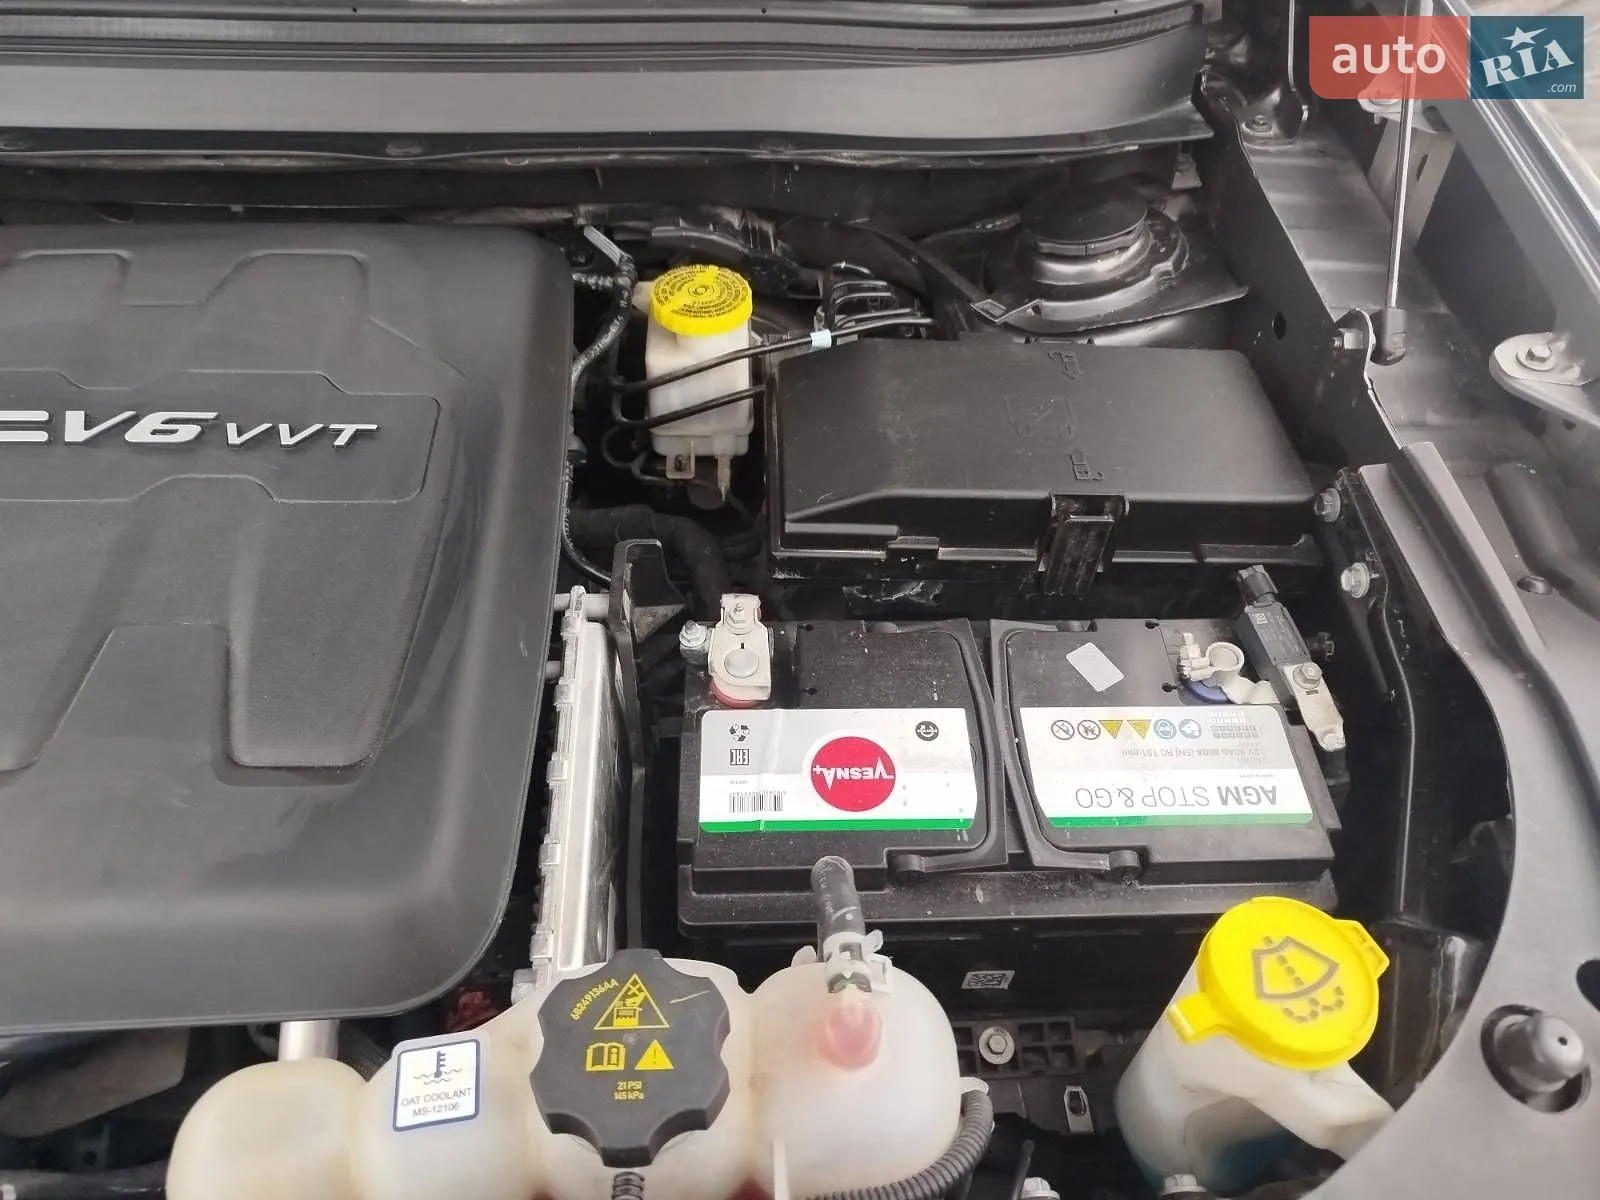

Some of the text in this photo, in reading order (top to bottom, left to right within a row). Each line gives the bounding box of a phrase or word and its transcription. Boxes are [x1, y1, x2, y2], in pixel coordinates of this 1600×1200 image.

[64, 410, 379, 447] V6 VVT
[1075, 785, 1277, 809] AGM STOP & GO
[628, 1080, 642, 1089] PSI
[400, 1087, 472, 1107] OAT COOLANT
